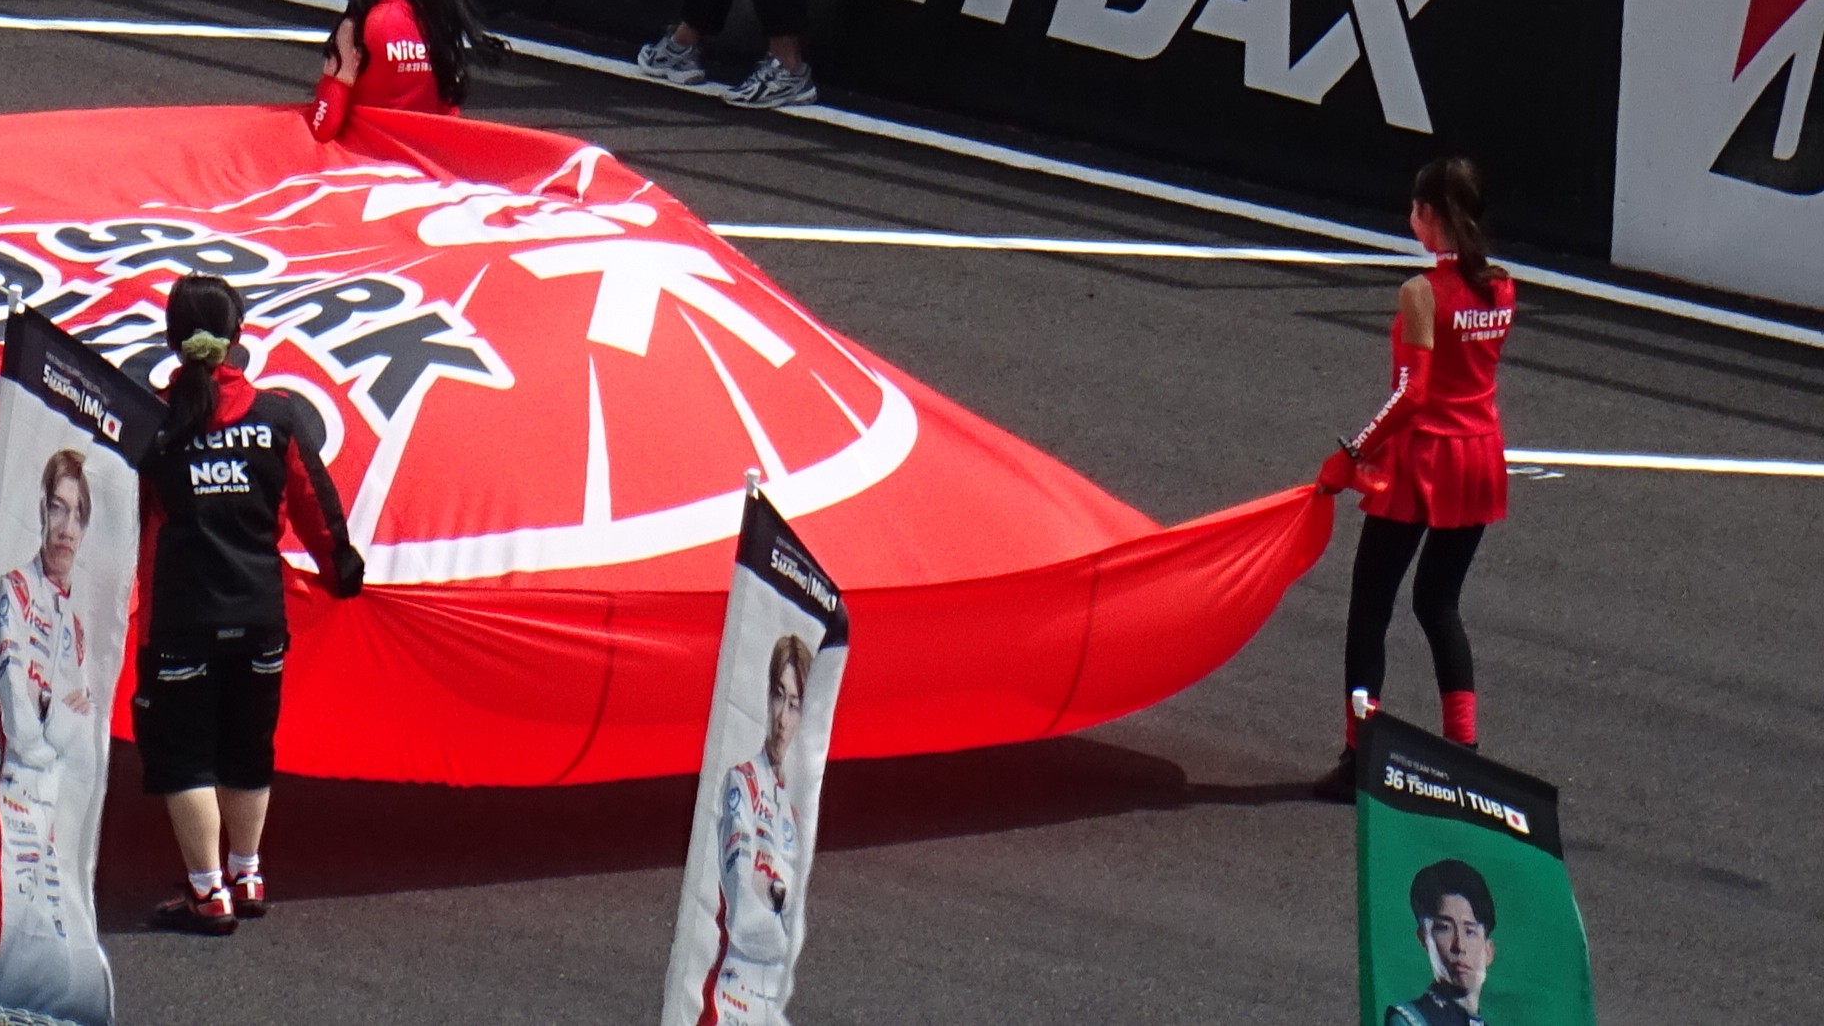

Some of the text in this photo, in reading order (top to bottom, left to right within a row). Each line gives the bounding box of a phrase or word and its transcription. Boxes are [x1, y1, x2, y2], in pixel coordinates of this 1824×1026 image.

[386, 40, 427, 62] Nite
[1453, 308, 1512, 330] Niterra
[184, 423, 273, 450] terra
[189, 460, 249, 486] NGK
[1383, 766, 1505, 821] 36 TSUBOI TUB
